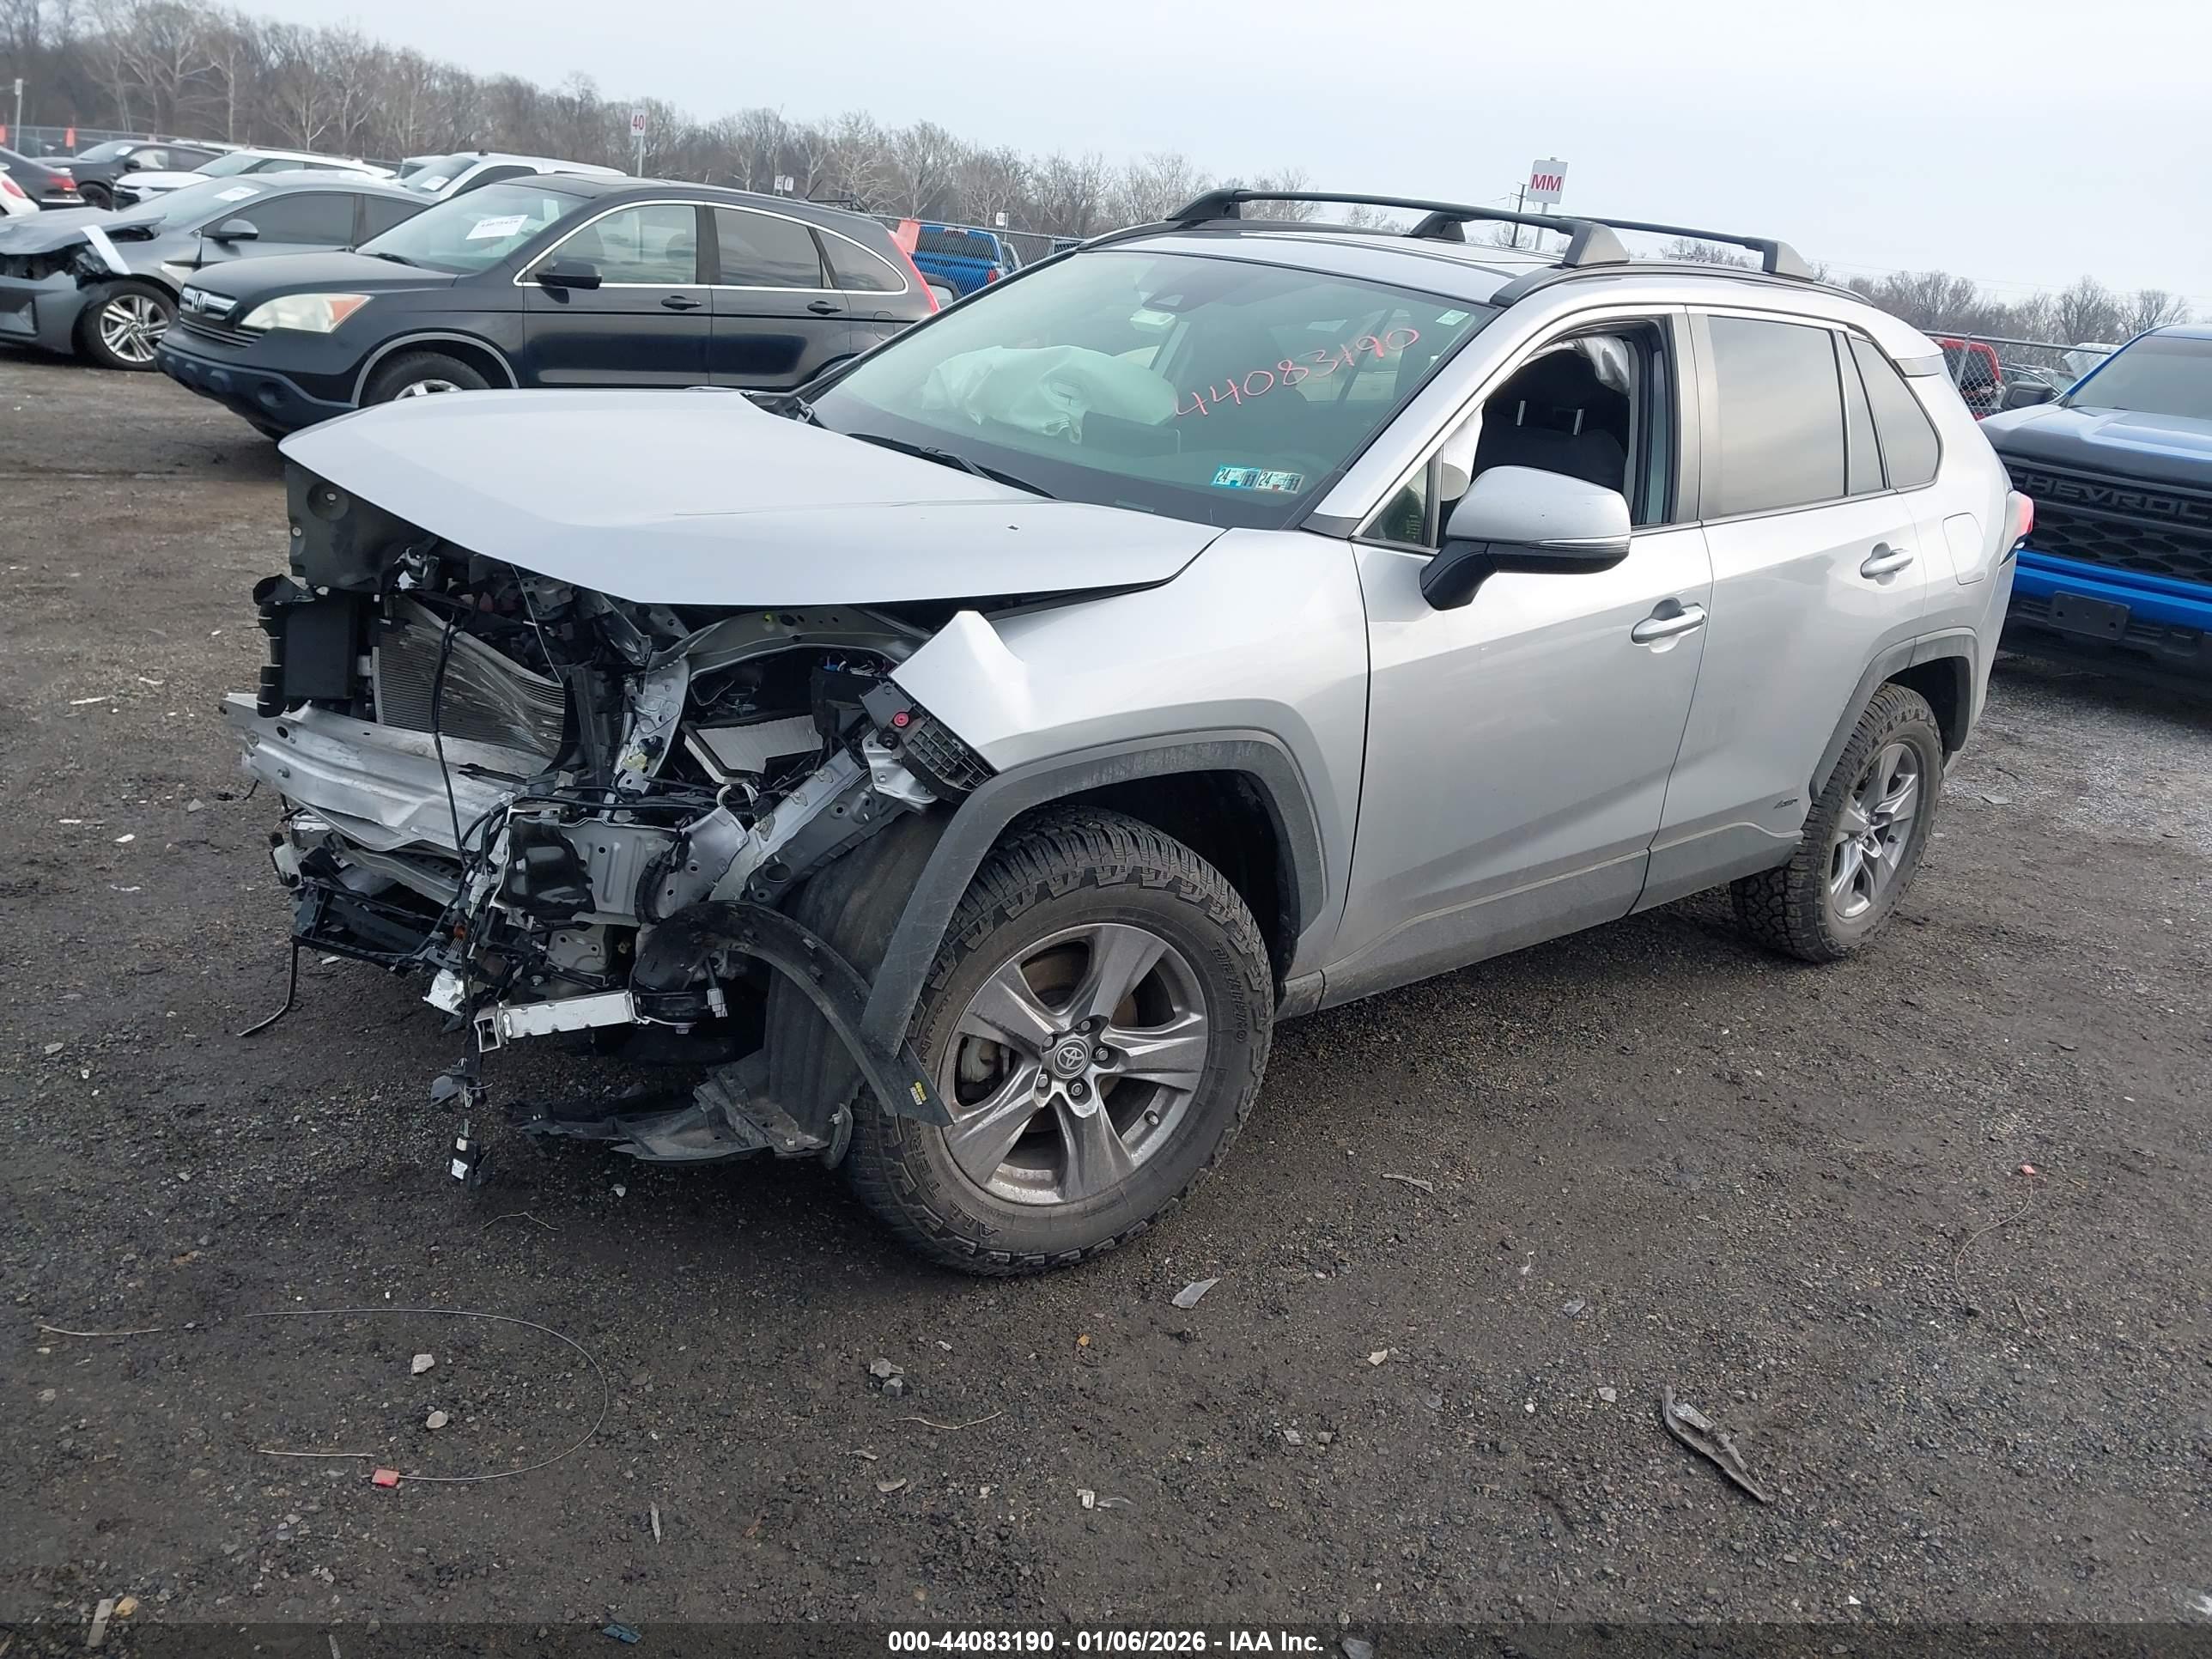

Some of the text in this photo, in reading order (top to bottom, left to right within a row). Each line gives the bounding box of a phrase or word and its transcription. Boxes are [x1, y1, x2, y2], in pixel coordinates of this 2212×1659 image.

[632, 115, 645, 131] 40
[1530, 174, 1562, 191] MM
[1175, 327, 1420, 416] 44083190
[1216, 468, 1231, 483] 24
[1258, 471, 1273, 487] 24
[949, 1201, 1002, 1238] ALL
